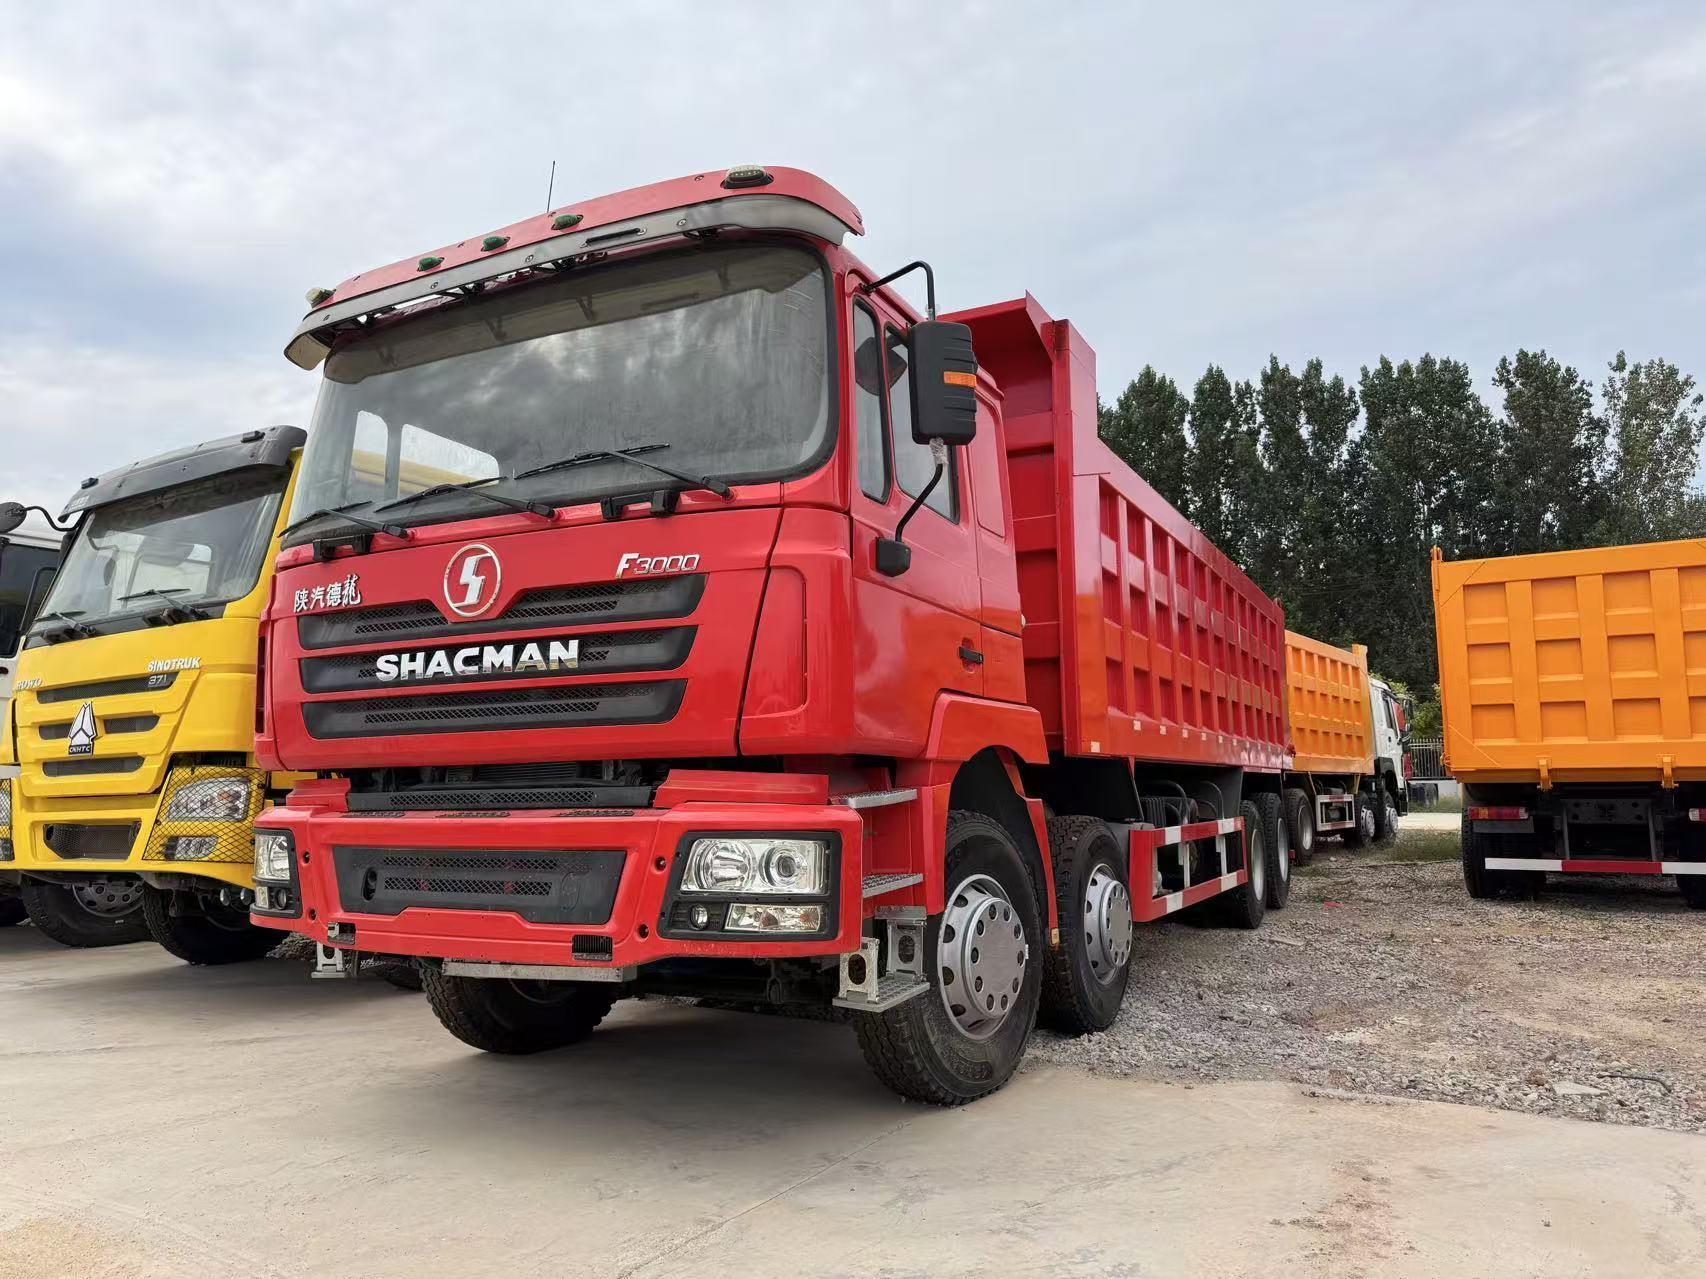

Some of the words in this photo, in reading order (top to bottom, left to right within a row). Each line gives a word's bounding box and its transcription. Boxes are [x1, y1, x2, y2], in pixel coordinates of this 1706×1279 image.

[615, 553, 700, 579] F3000
[147, 657, 200, 672] SINOTRUK
[375, 639, 579, 681] SHACMAN
[148, 675, 167, 685] 371
